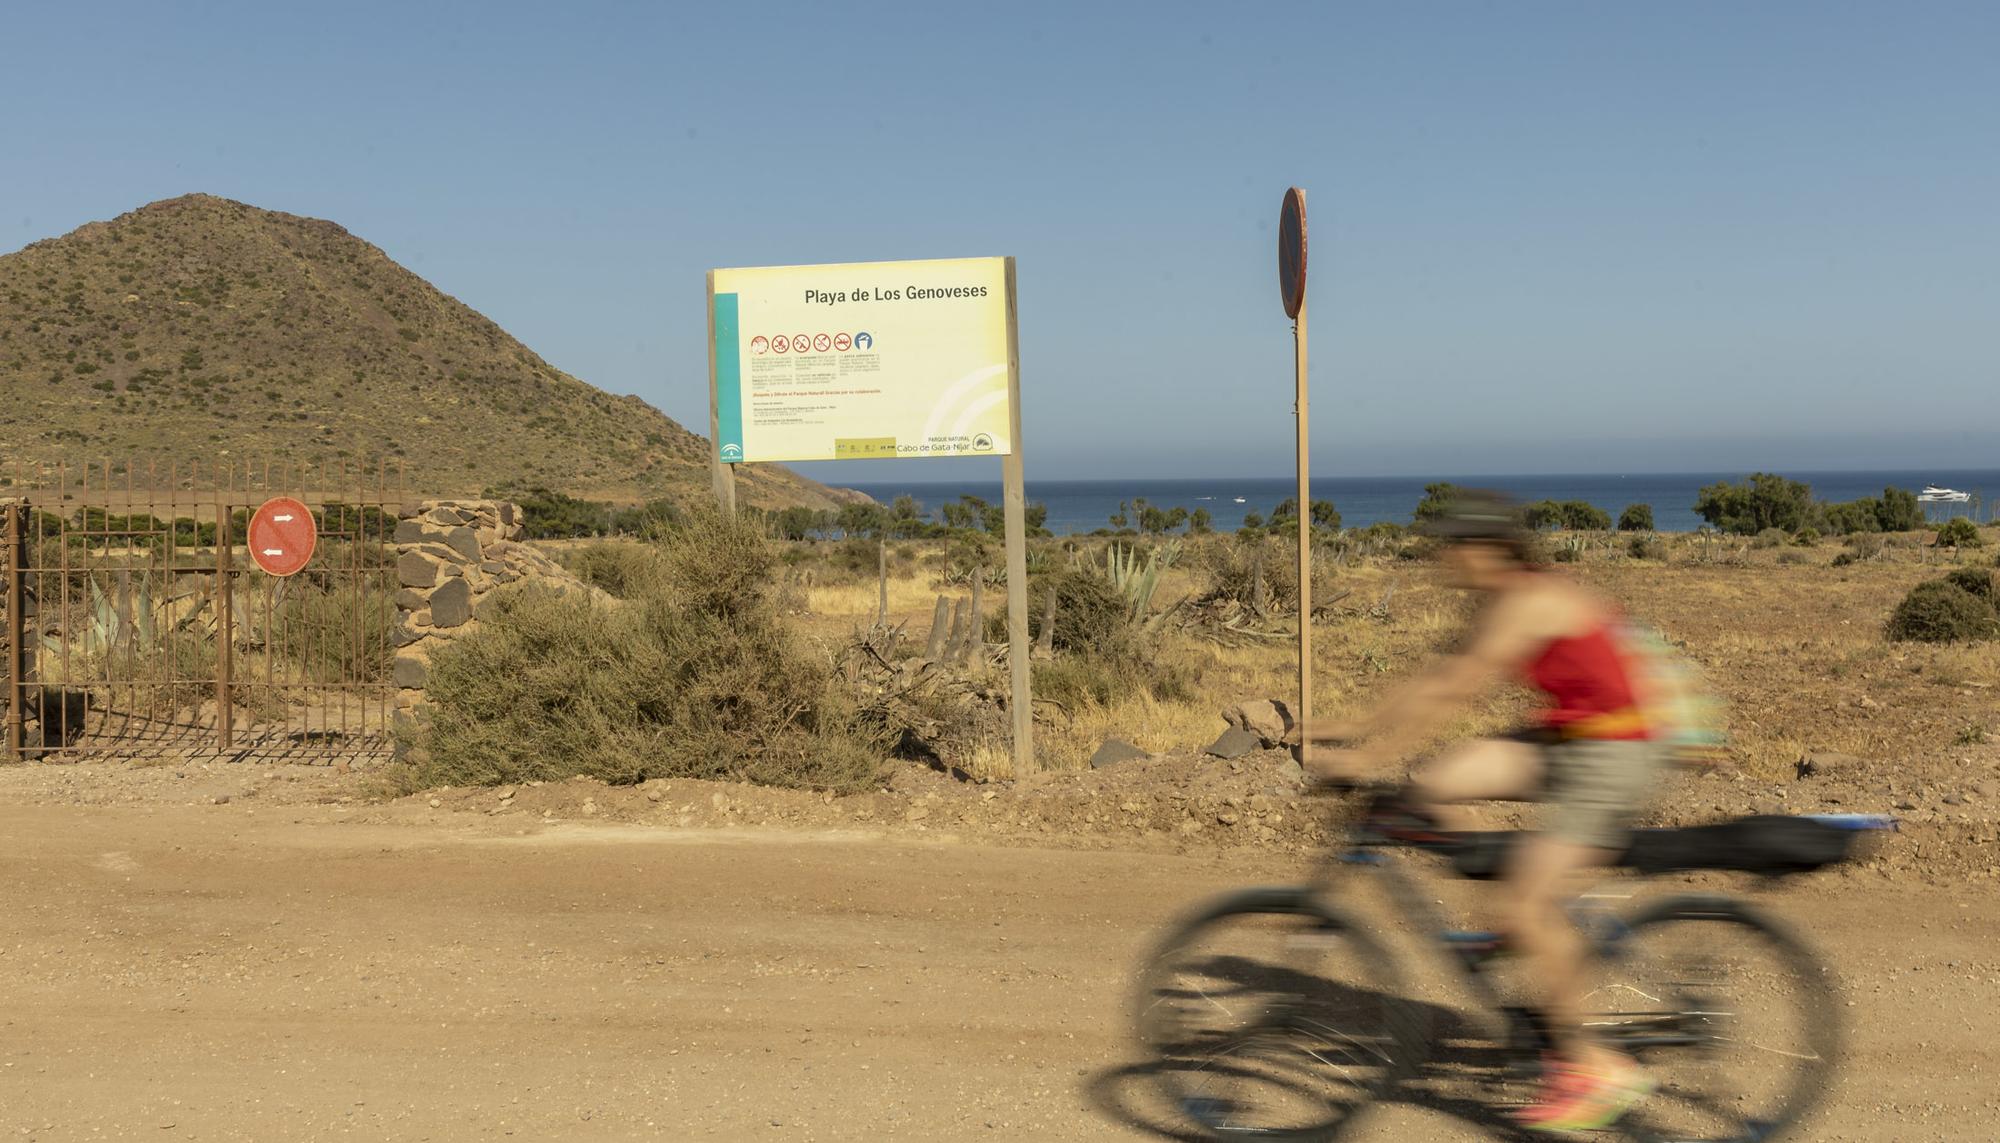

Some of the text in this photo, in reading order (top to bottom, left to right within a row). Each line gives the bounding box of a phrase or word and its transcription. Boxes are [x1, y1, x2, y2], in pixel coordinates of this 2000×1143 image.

[805, 285, 988, 306] Playa de Los Genoveses
[897, 443, 919, 453] Cabo
[919, 443, 930, 452] de
